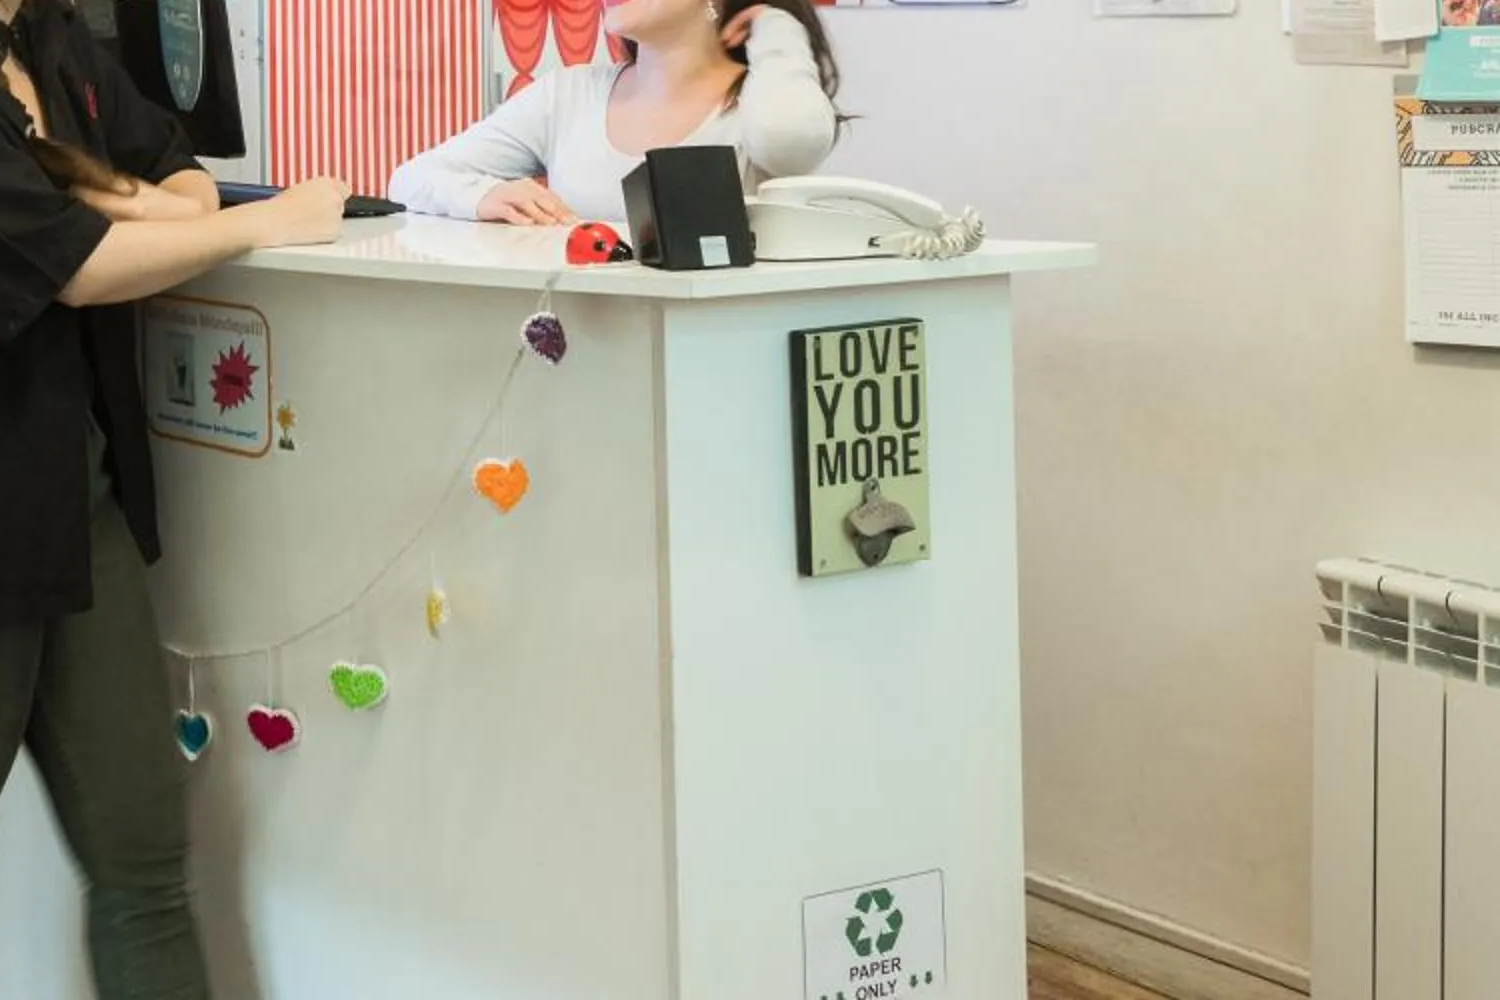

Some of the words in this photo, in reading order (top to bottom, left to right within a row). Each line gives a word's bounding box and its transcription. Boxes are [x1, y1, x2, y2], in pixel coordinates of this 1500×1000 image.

[813, 325, 919, 381] LOVE
[813, 373, 920, 439] YOU
[816, 431, 922, 488] MORE
[849, 956, 902, 983] PAPER
[855, 979, 898, 1000] ONLY
